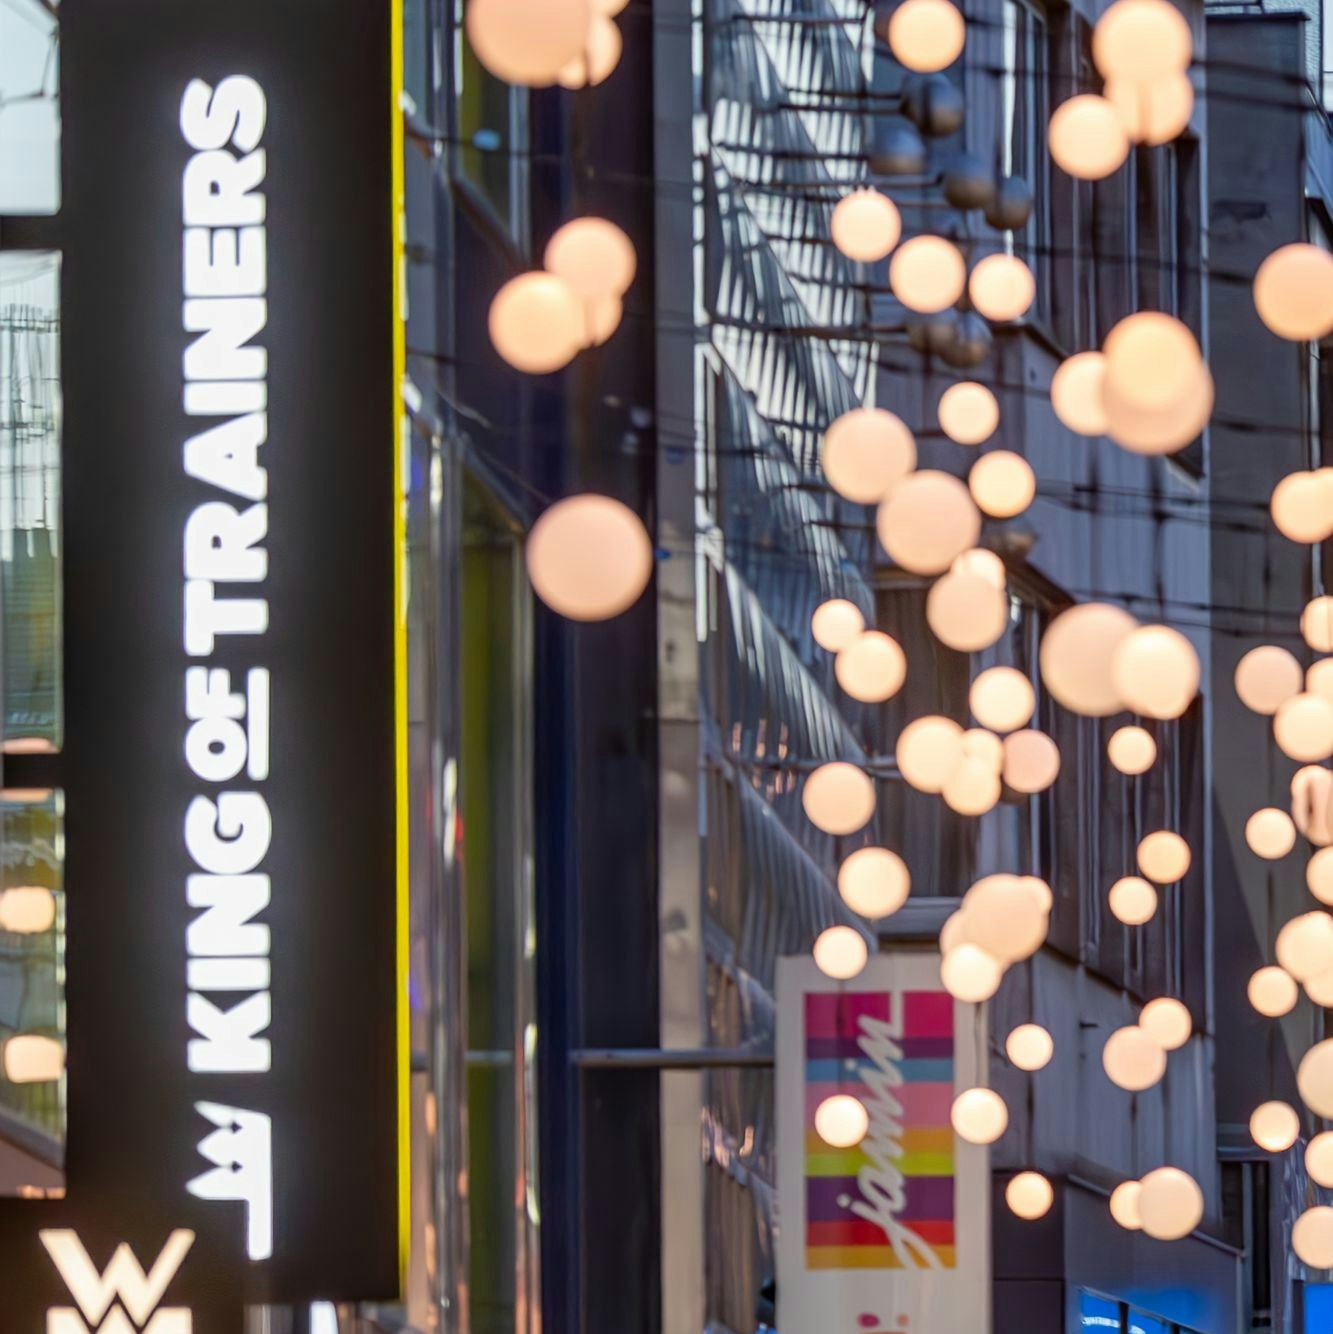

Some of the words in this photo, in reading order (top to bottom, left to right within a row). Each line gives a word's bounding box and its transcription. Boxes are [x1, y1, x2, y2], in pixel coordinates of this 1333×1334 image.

[180, 74, 269, 655] TRAINERS
[184, 665, 248, 783] OF
[185, 790, 272, 1073] KING
